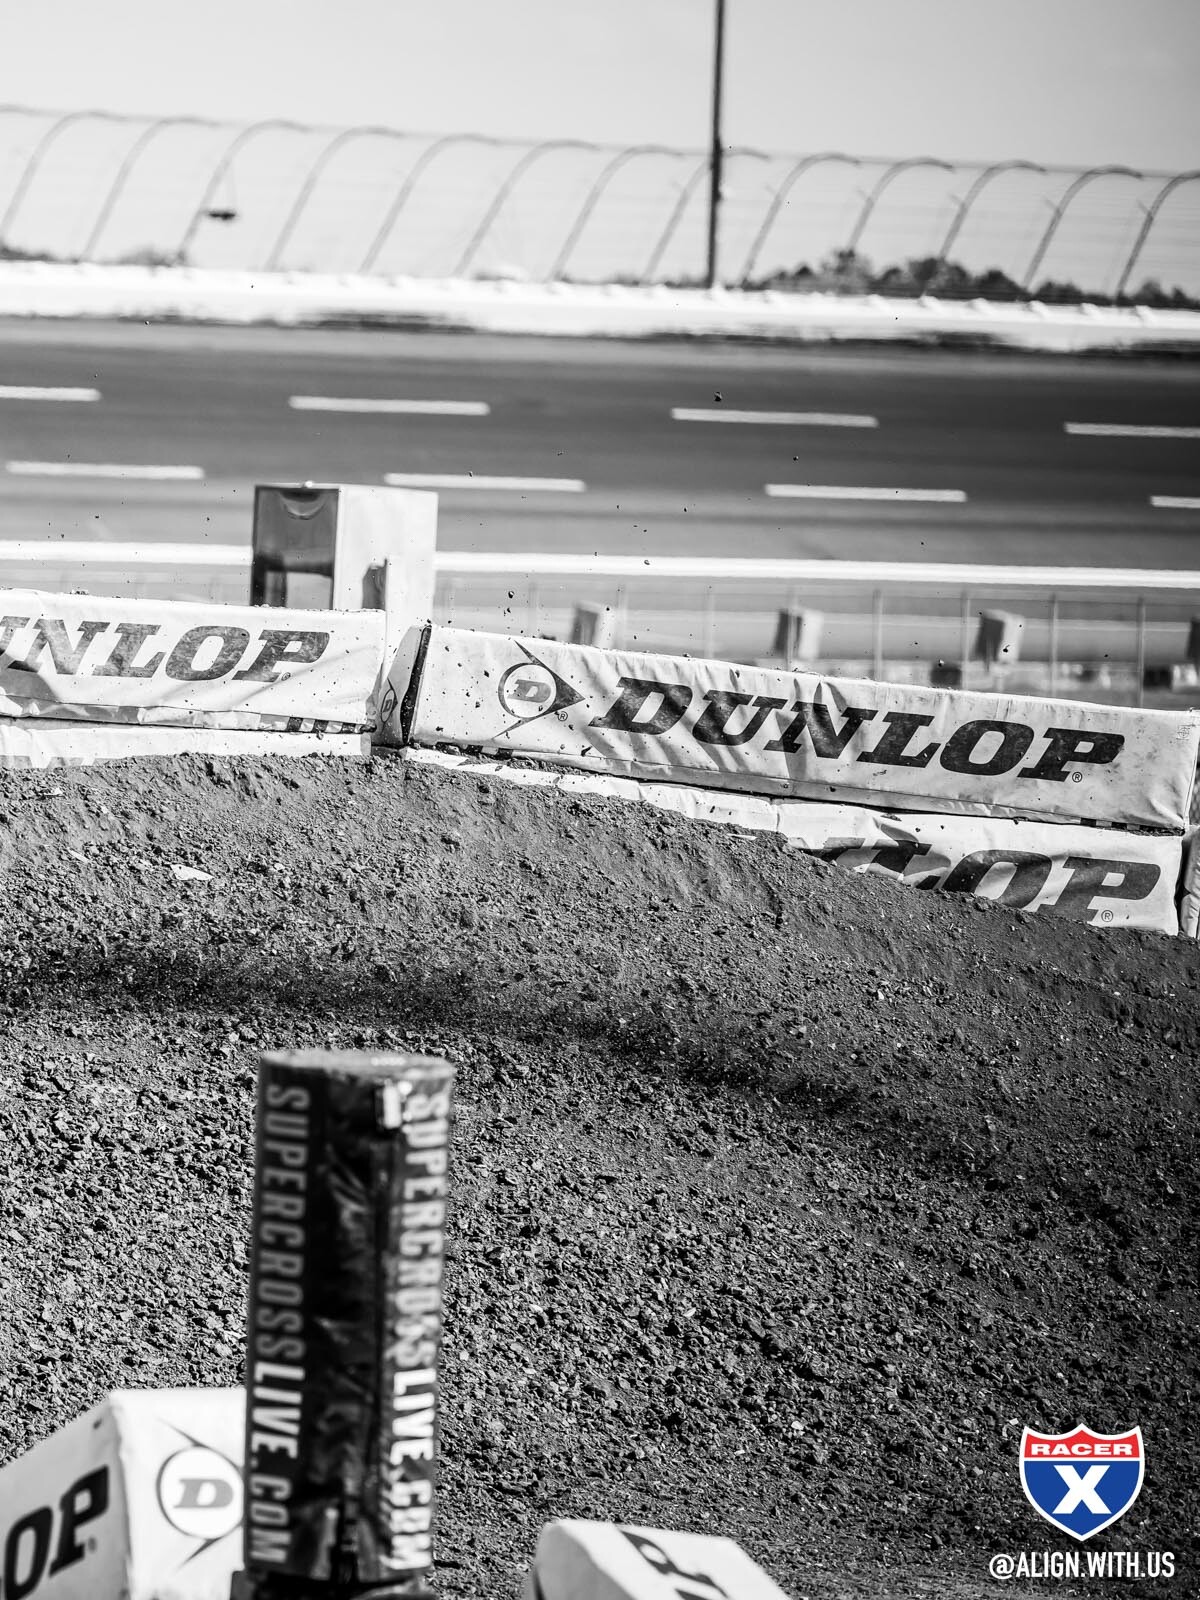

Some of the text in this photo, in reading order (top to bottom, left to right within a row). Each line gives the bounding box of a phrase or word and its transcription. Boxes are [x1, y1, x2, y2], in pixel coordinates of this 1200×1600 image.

[507, 678, 551, 704] D
[587, 676, 1125, 783] DUNLOP
[173, 1477, 234, 1509] D
